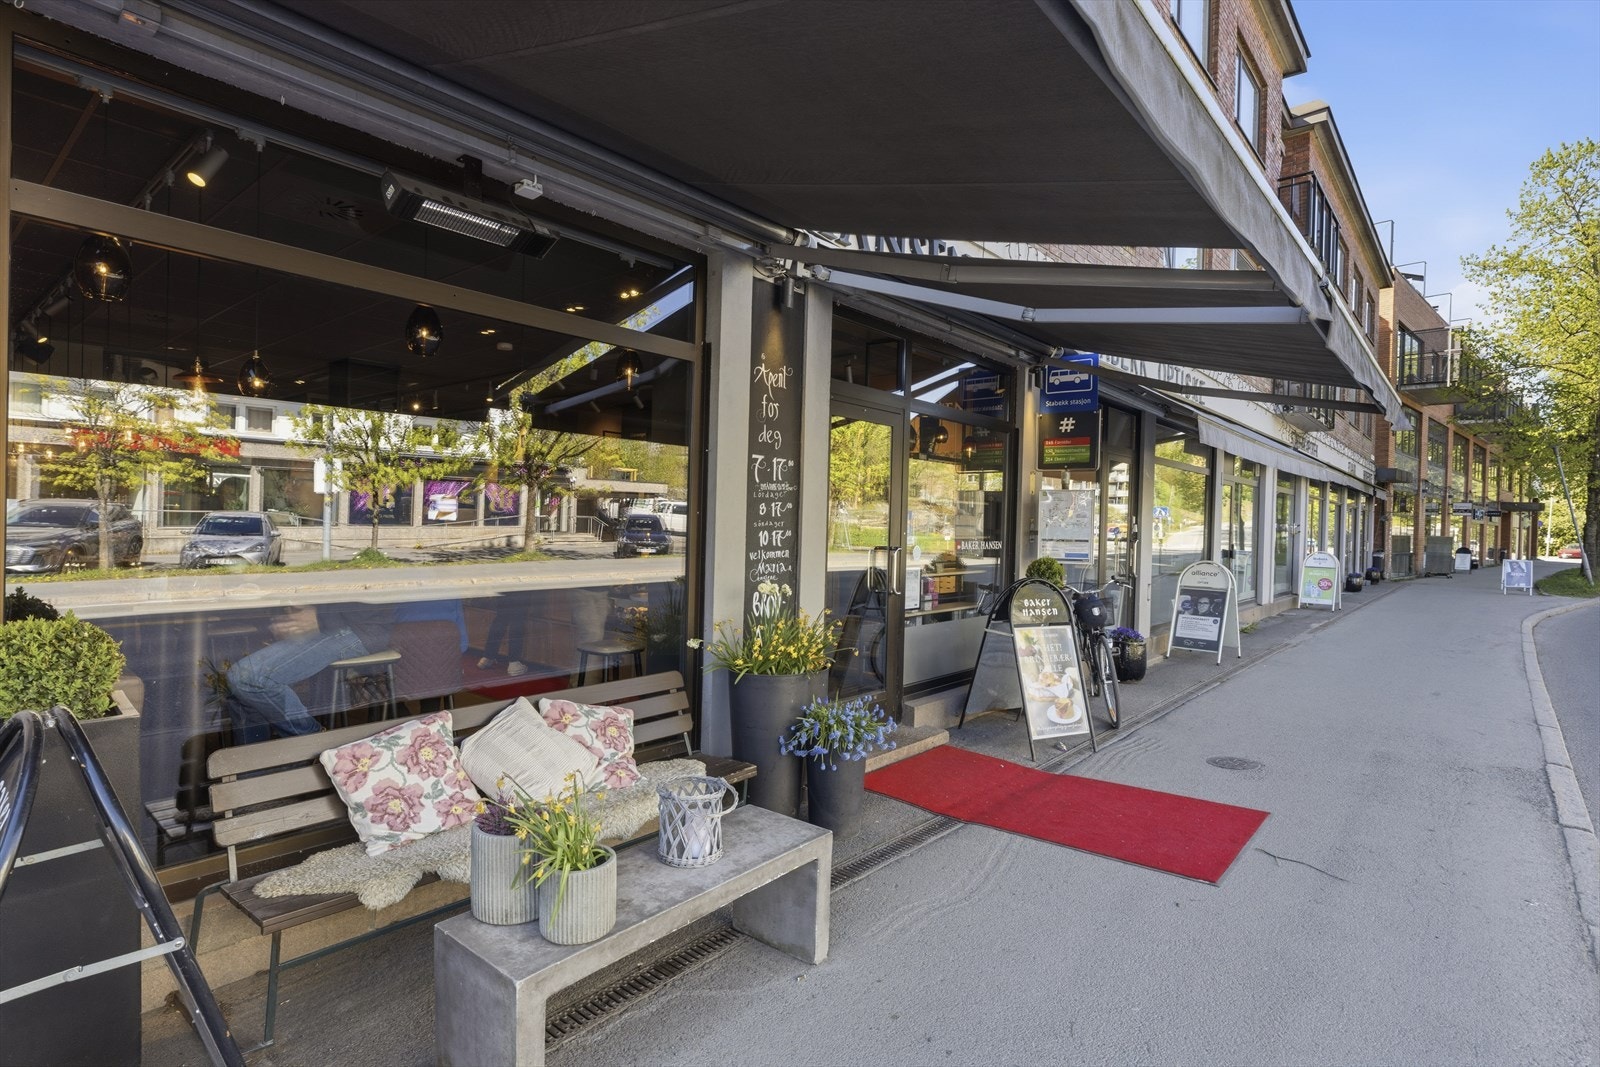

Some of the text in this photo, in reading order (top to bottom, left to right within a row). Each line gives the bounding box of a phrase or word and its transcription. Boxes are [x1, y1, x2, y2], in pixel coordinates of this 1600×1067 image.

[1070, 398, 1091, 406] stasjon
[758, 424, 781, 450] deg
[961, 540, 1003, 550] BAKER HANSEN
[1023, 598, 1051, 608] BAKER
[1022, 607, 1059, 617] HANSEN
